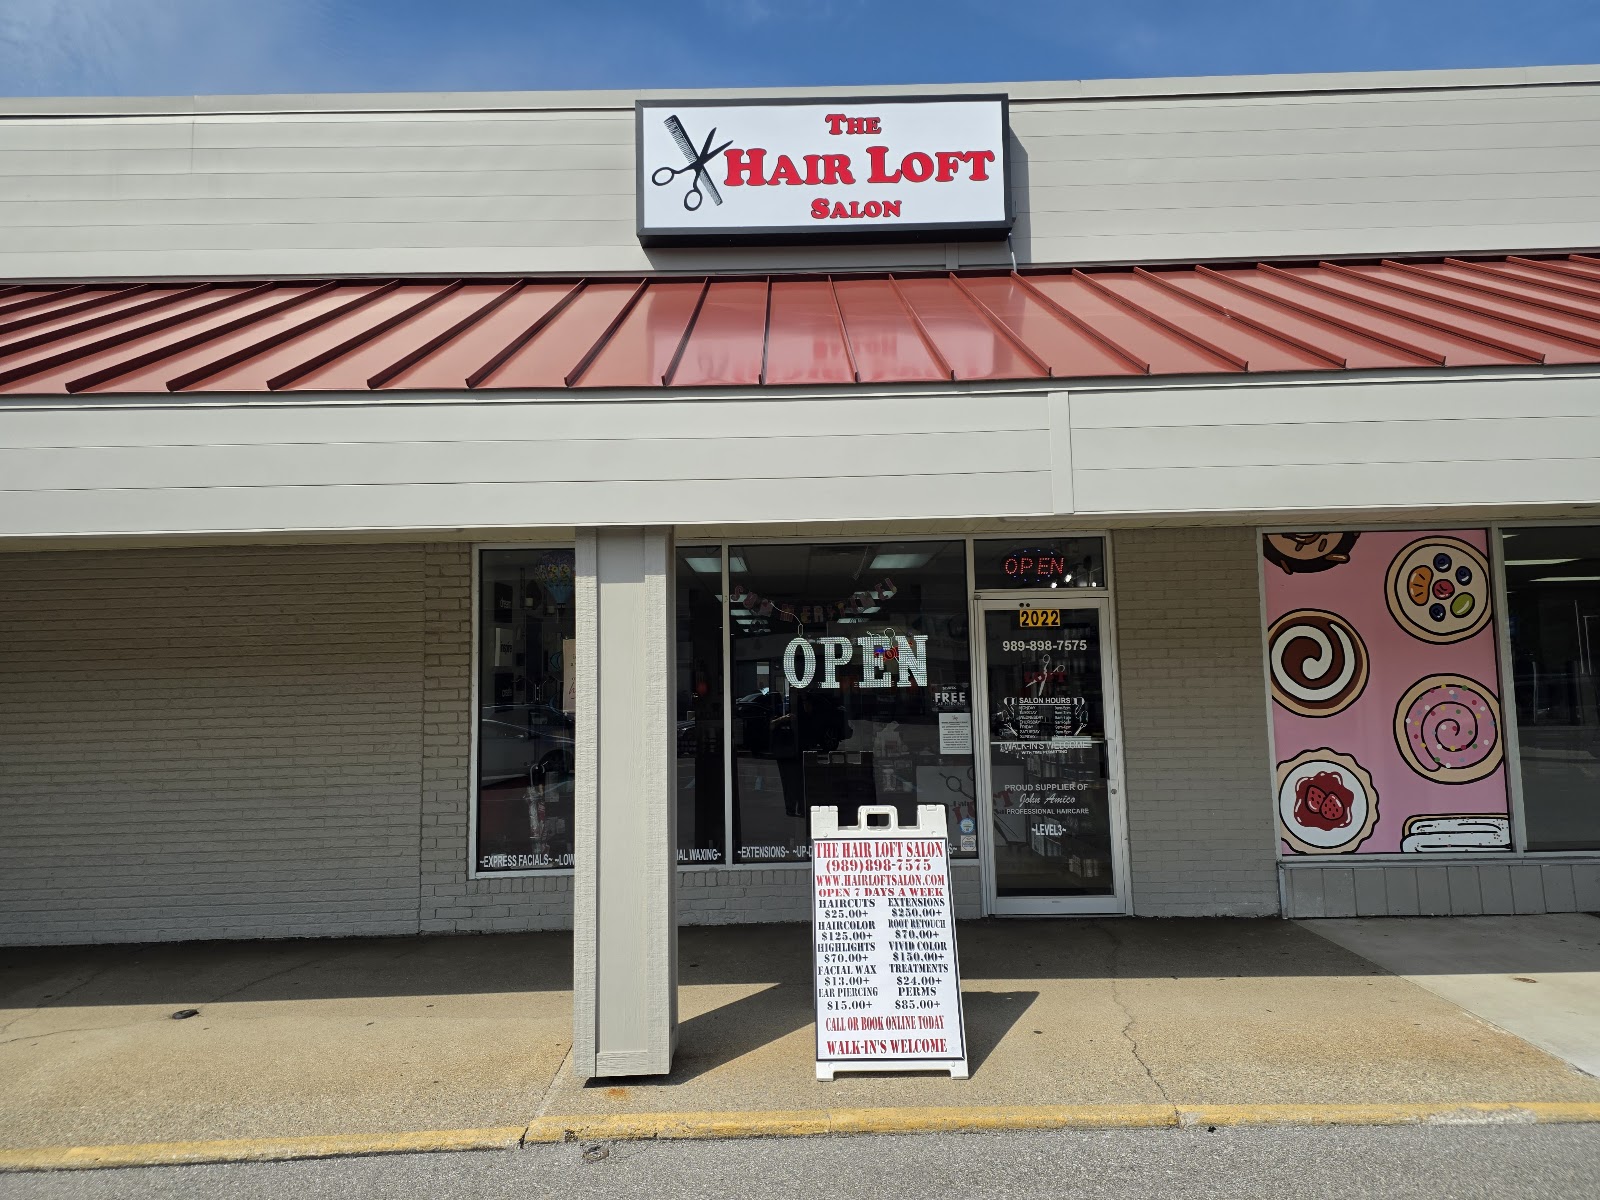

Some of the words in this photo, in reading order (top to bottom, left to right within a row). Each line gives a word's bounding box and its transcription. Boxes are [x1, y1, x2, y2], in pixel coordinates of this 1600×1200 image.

[825, 114, 882, 135] THE
[723, 147, 856, 187] HAIR
[866, 145, 996, 184] LOFT
[811, 198, 902, 219] SALON
[1004, 557, 1065, 575] OPEN
[1020, 610, 1059, 626] 2022
[1002, 639, 1088, 652] 989-898-7575
[783, 635, 929, 689] OPEN
[934, 692, 966, 703] FREE
[1035, 783, 1075, 791] SUPPLIER
[1077, 783, 1089, 791] OF
[1019, 793, 1041, 808] John
[1044, 793, 1076, 805] Amico
[815, 843, 839, 858] THE
[842, 842, 872, 858] HAIR
[875, 842, 904, 858] LOFT
[906, 842, 943, 858] SALON
[826, 859, 931, 874] (989)898-7575
[816, 874, 945, 887] WWW.HAIRLOFTSALON.COM
[818, 888, 851, 897] OPEN
[854, 888, 860, 897] 7
[864, 888, 895, 897] DAYS
[898, 888, 906, 896] A
[909, 888, 943, 896] WEEK
[818, 899, 876, 908] HAIRCUTS
[888, 898, 945, 907] EXTENSIONS
[824, 909, 869, 918] $25.00+
[891, 908, 942, 918] $250.00+
[818, 921, 876, 930] HAIRCOLOR
[888, 919, 909, 929] ROOT
[910, 919, 946, 929] RETOUCH
[821, 931, 873, 941] $125.00+
[895, 930, 940, 939] $70.00+
[817, 942, 876, 952] HIGHLIGHTS
[889, 941, 915, 951] VIVID
[917, 941, 948, 951] COLOR
[824, 953, 869, 963] $70.00+
[893, 952, 944, 962] $150.00+
[818, 965, 853, 975] FACIAL
[855, 965, 877, 974] WAX
[889, 964, 949, 973] TREATMENTS
[896, 976, 942, 985] $24.00+
[818, 988, 835, 998] EAR
[837, 987, 878, 997] PIERCING
[898, 986, 937, 996] PERMS
[827, 1000, 873, 1010] $15.00+
[895, 1000, 941, 1009] $85.00+
[825, 1017, 846, 1031] CALL
[848, 1017, 859, 1031] OR
[861, 1016, 884, 1030] BOOK
[885, 1015, 916, 1030] ONLINE
[918, 1015, 944, 1030] TODAY
[826, 1039, 887, 1055] WALK-IN'S
[890, 1039, 948, 1053] WELCOME
